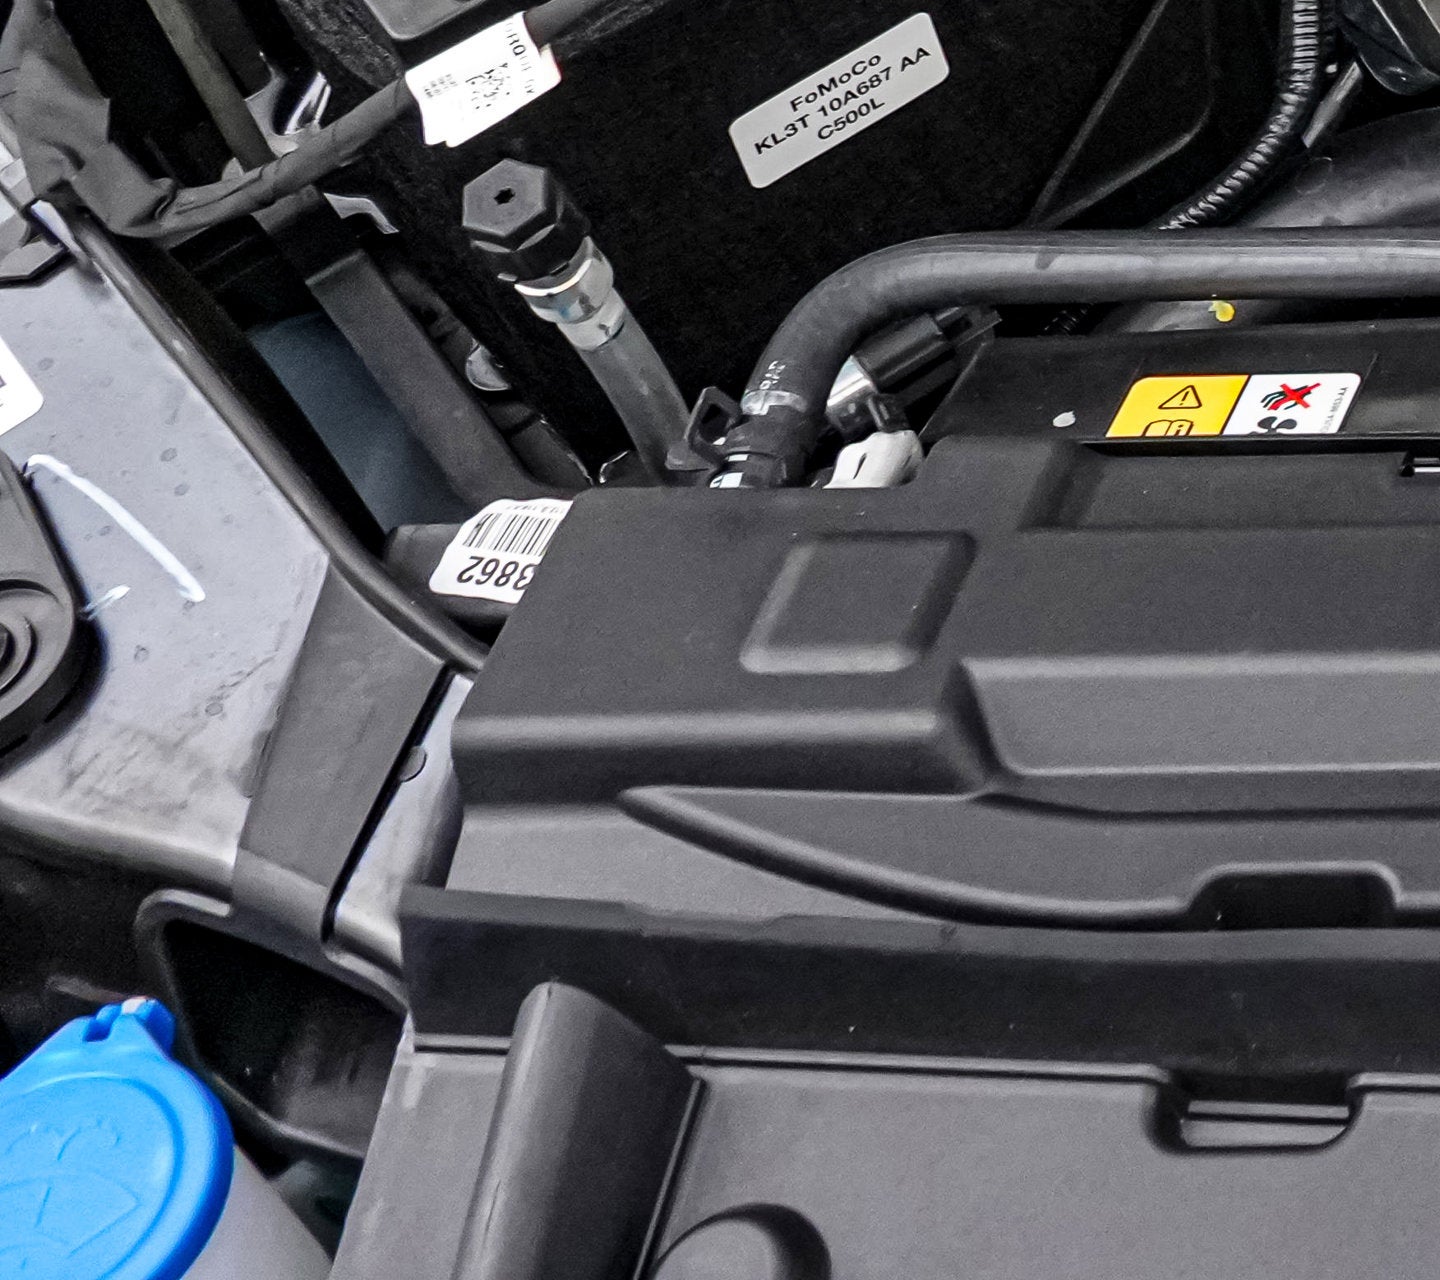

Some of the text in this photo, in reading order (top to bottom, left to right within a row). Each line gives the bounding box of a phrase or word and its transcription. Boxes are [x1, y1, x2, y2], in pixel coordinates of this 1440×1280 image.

[754, 47, 931, 155] KL3T 10A687 AA
[789, 54, 882, 112] FoMoCo
[817, 97, 885, 141] C500L
